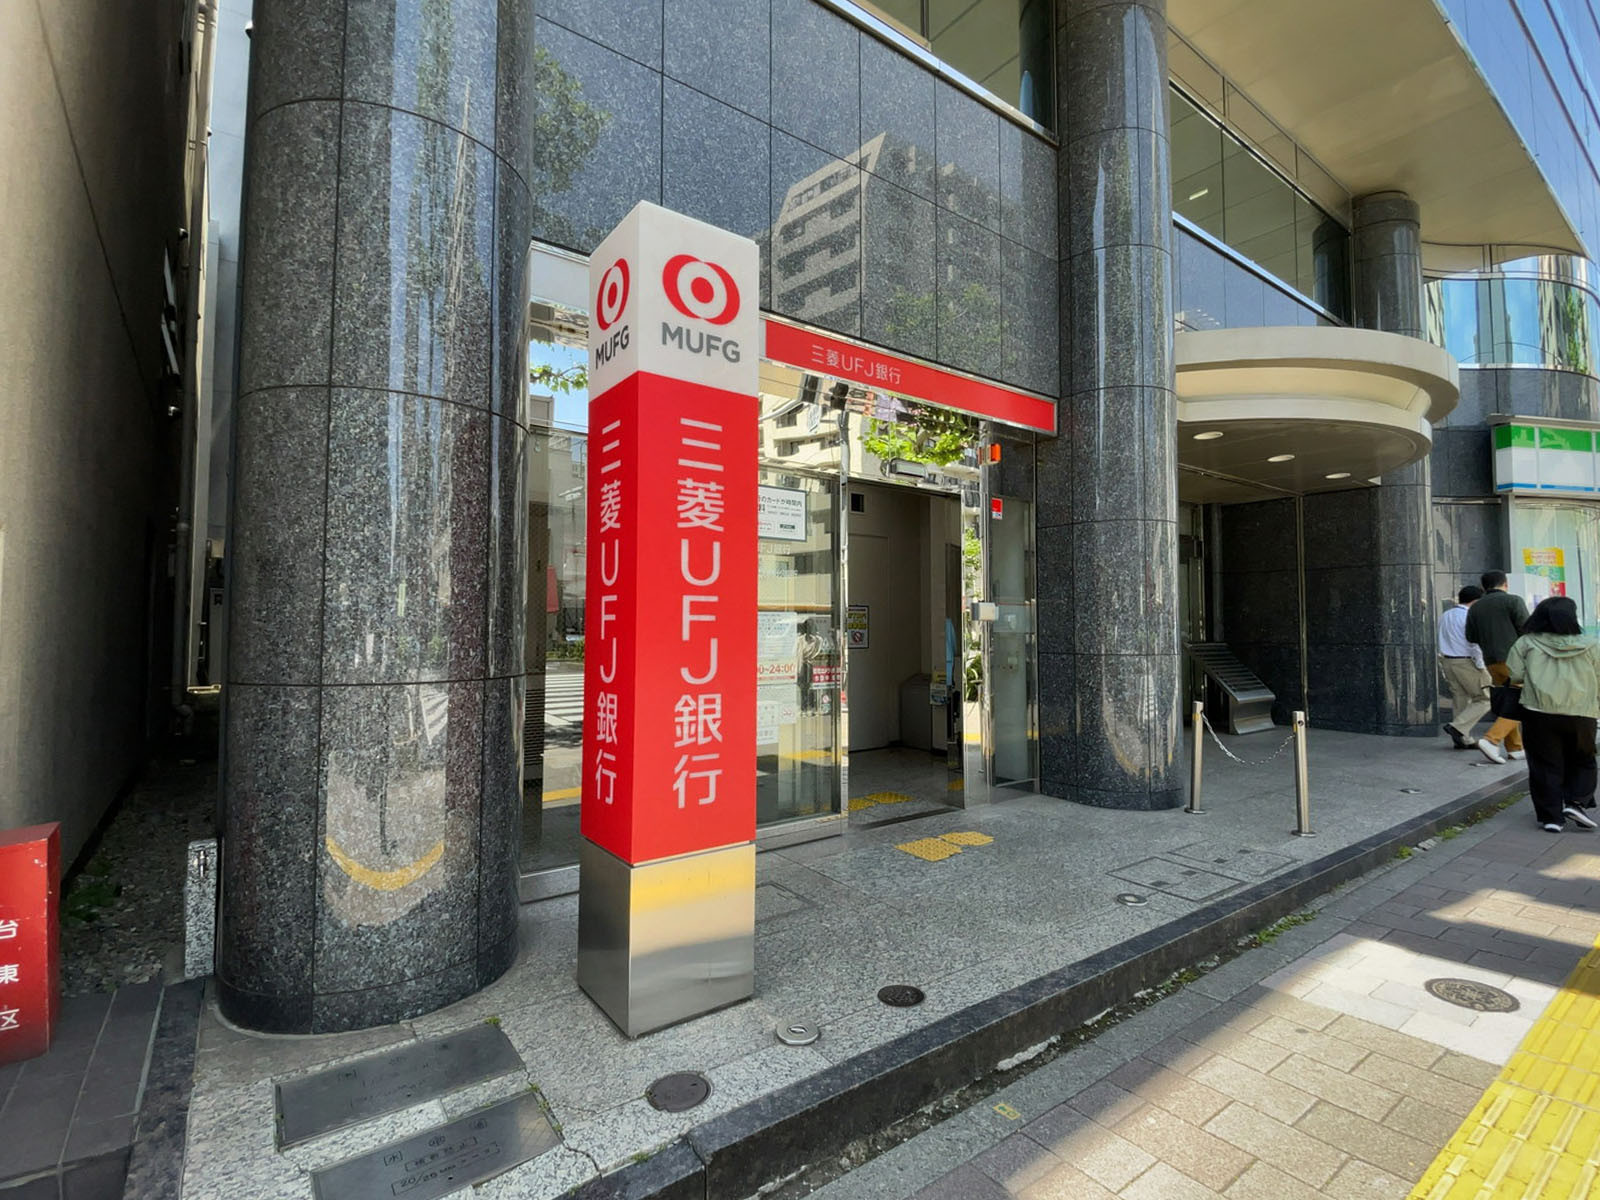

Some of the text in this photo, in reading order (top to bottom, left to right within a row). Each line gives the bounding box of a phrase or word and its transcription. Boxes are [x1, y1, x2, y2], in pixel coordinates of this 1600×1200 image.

[595, 325, 630, 370] MUFG
[661, 322, 741, 363] MUFG
[811, 344, 902, 385] 三菱UFJ銀行
[595, 419, 622, 806] 三菱UFJ銀行
[672, 417, 725, 809] 三菱UFJ銀行
